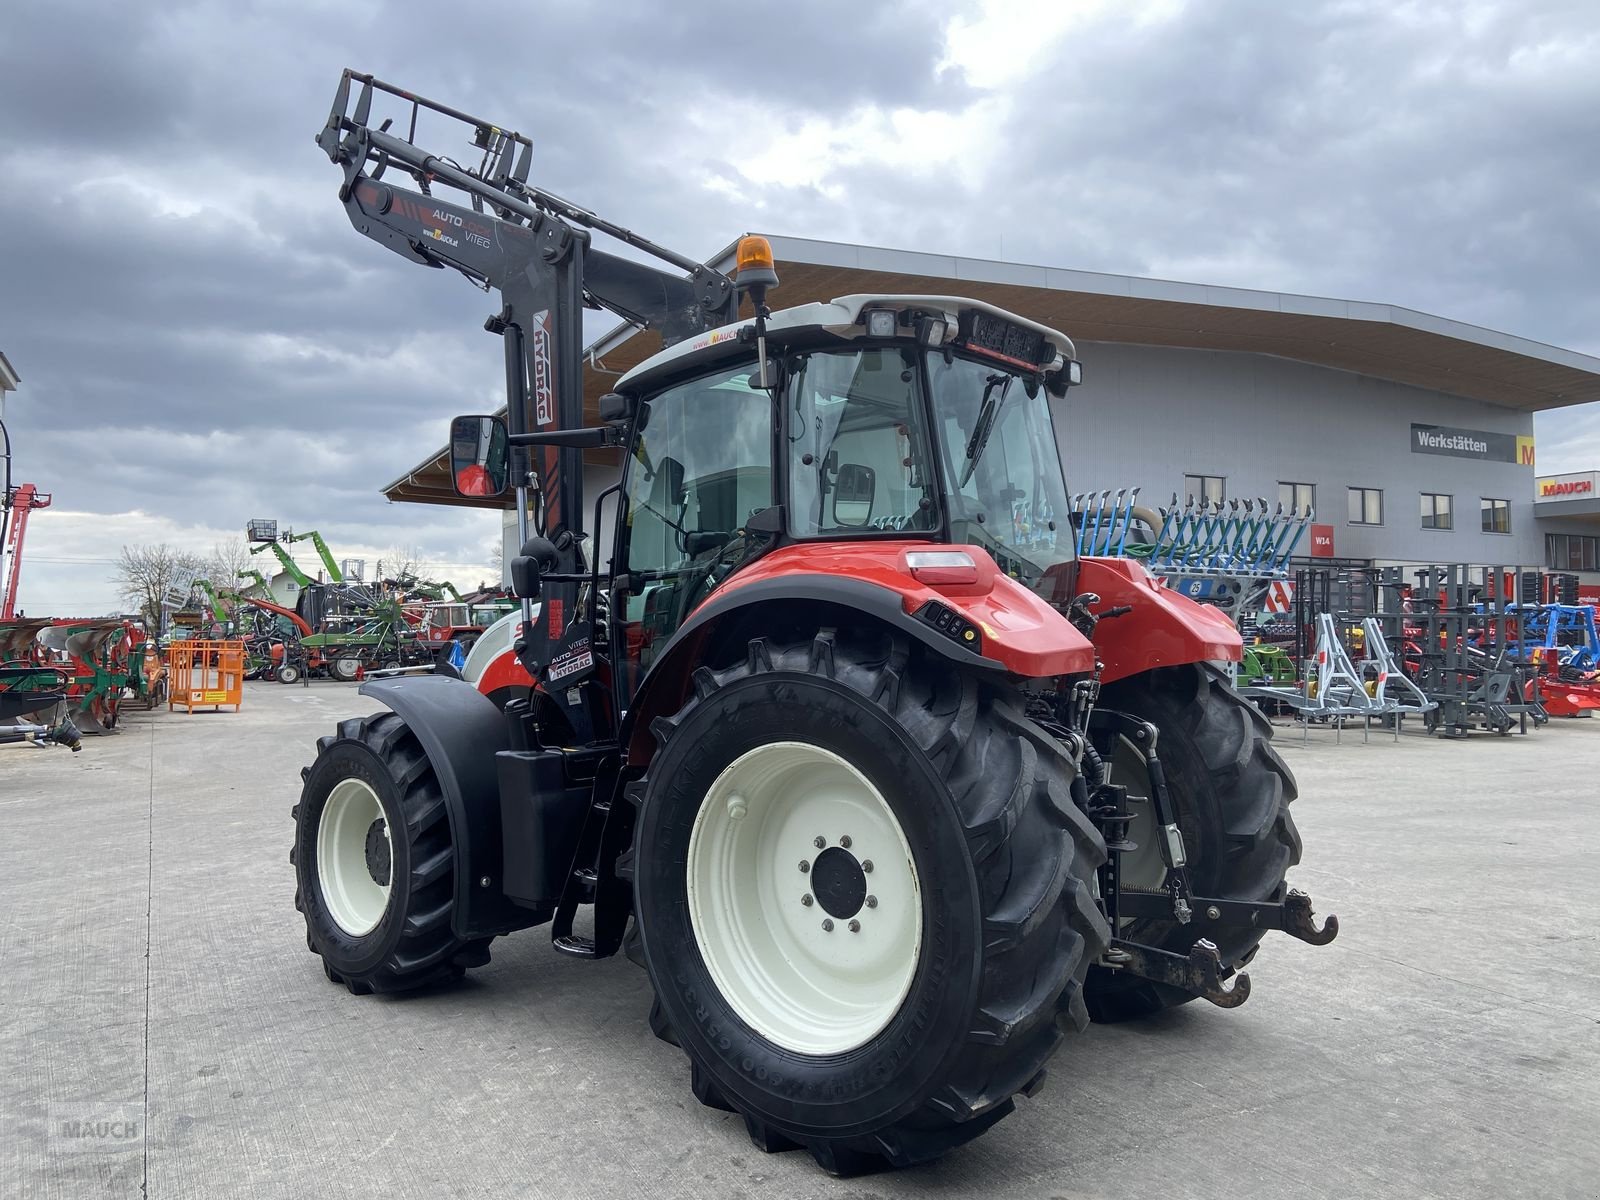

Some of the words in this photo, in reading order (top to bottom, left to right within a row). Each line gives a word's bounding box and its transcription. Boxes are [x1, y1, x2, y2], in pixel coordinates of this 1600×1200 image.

[534, 330, 546, 420] HYDRAC
[1417, 431, 1487, 453] Werkstätten
[1543, 480, 1591, 497] MAUCH
[1315, 536, 1330, 546] W14
[1191, 583, 1200, 593] 25
[555, 658, 591, 678] HYDRAC
